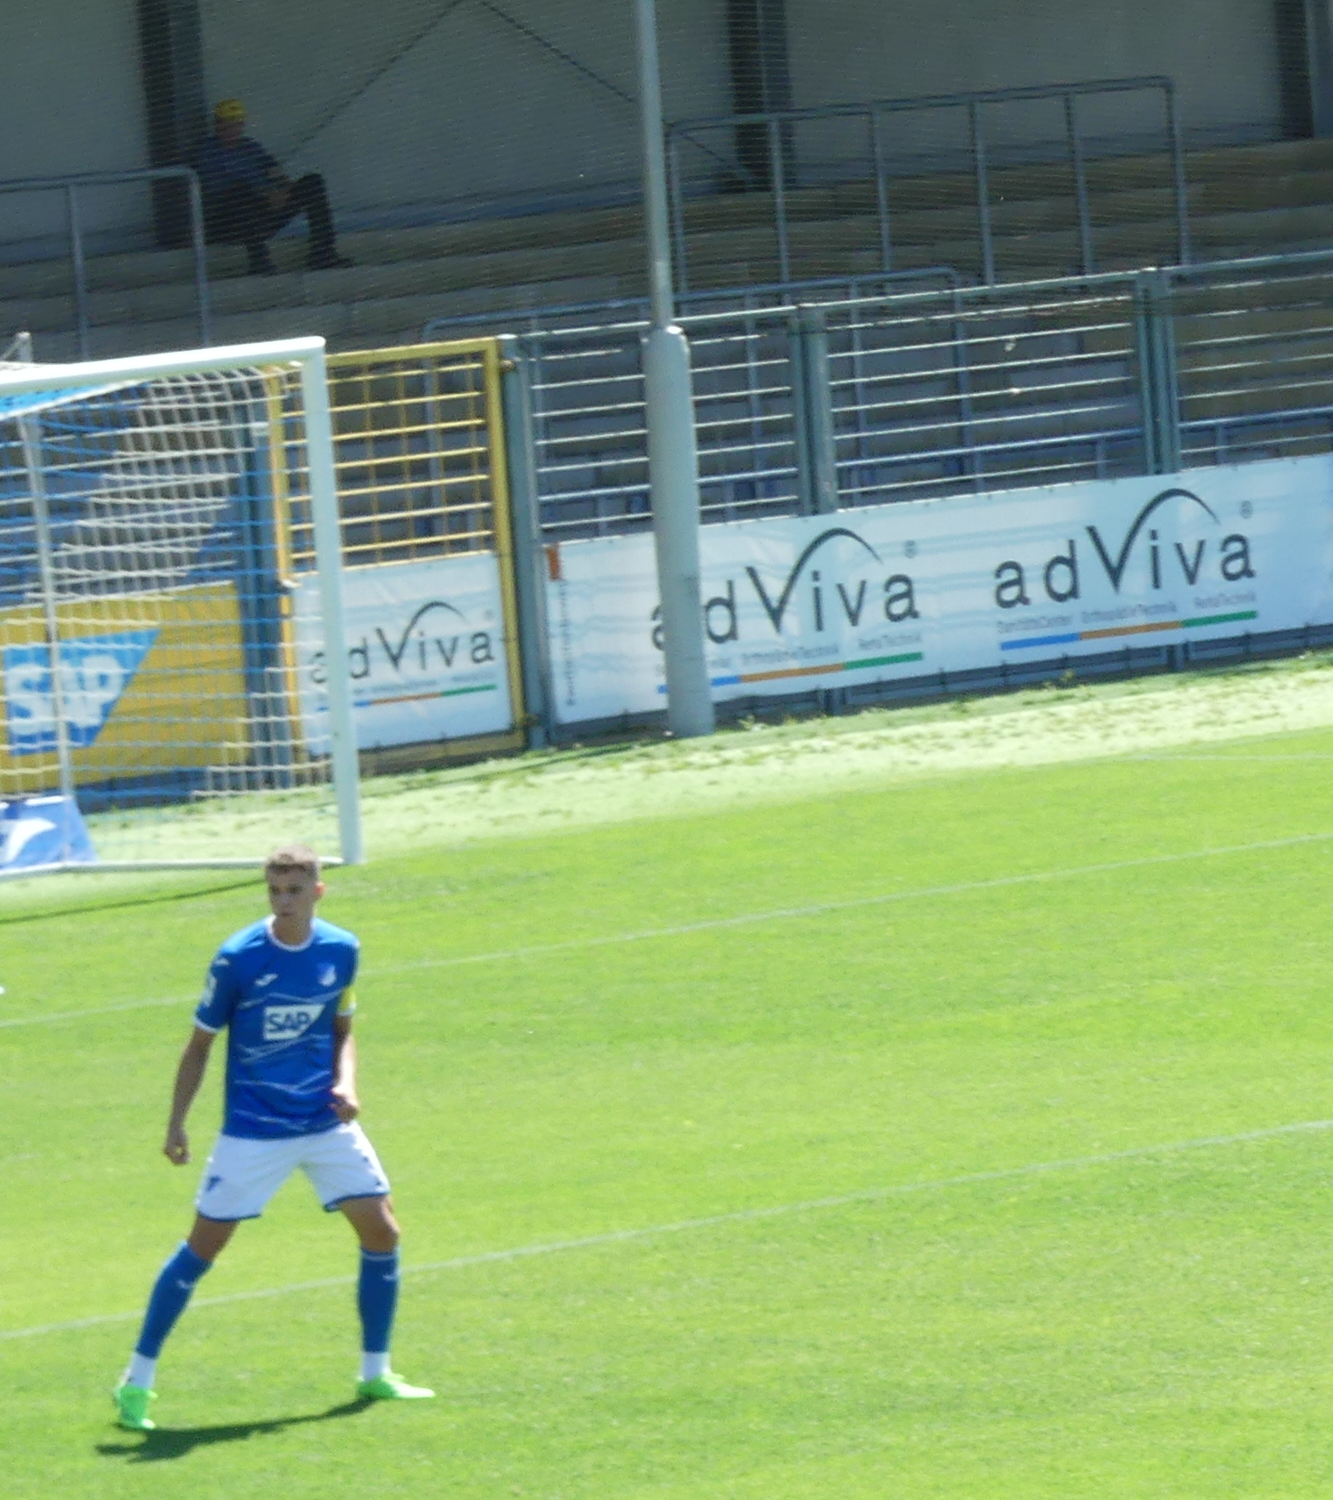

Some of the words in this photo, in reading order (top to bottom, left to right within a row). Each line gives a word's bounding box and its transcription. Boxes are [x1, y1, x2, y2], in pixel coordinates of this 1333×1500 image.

[994, 488, 1257, 609] adViva
[5, 655, 124, 735] SAP
[268, 1011, 310, 1034] SAP
